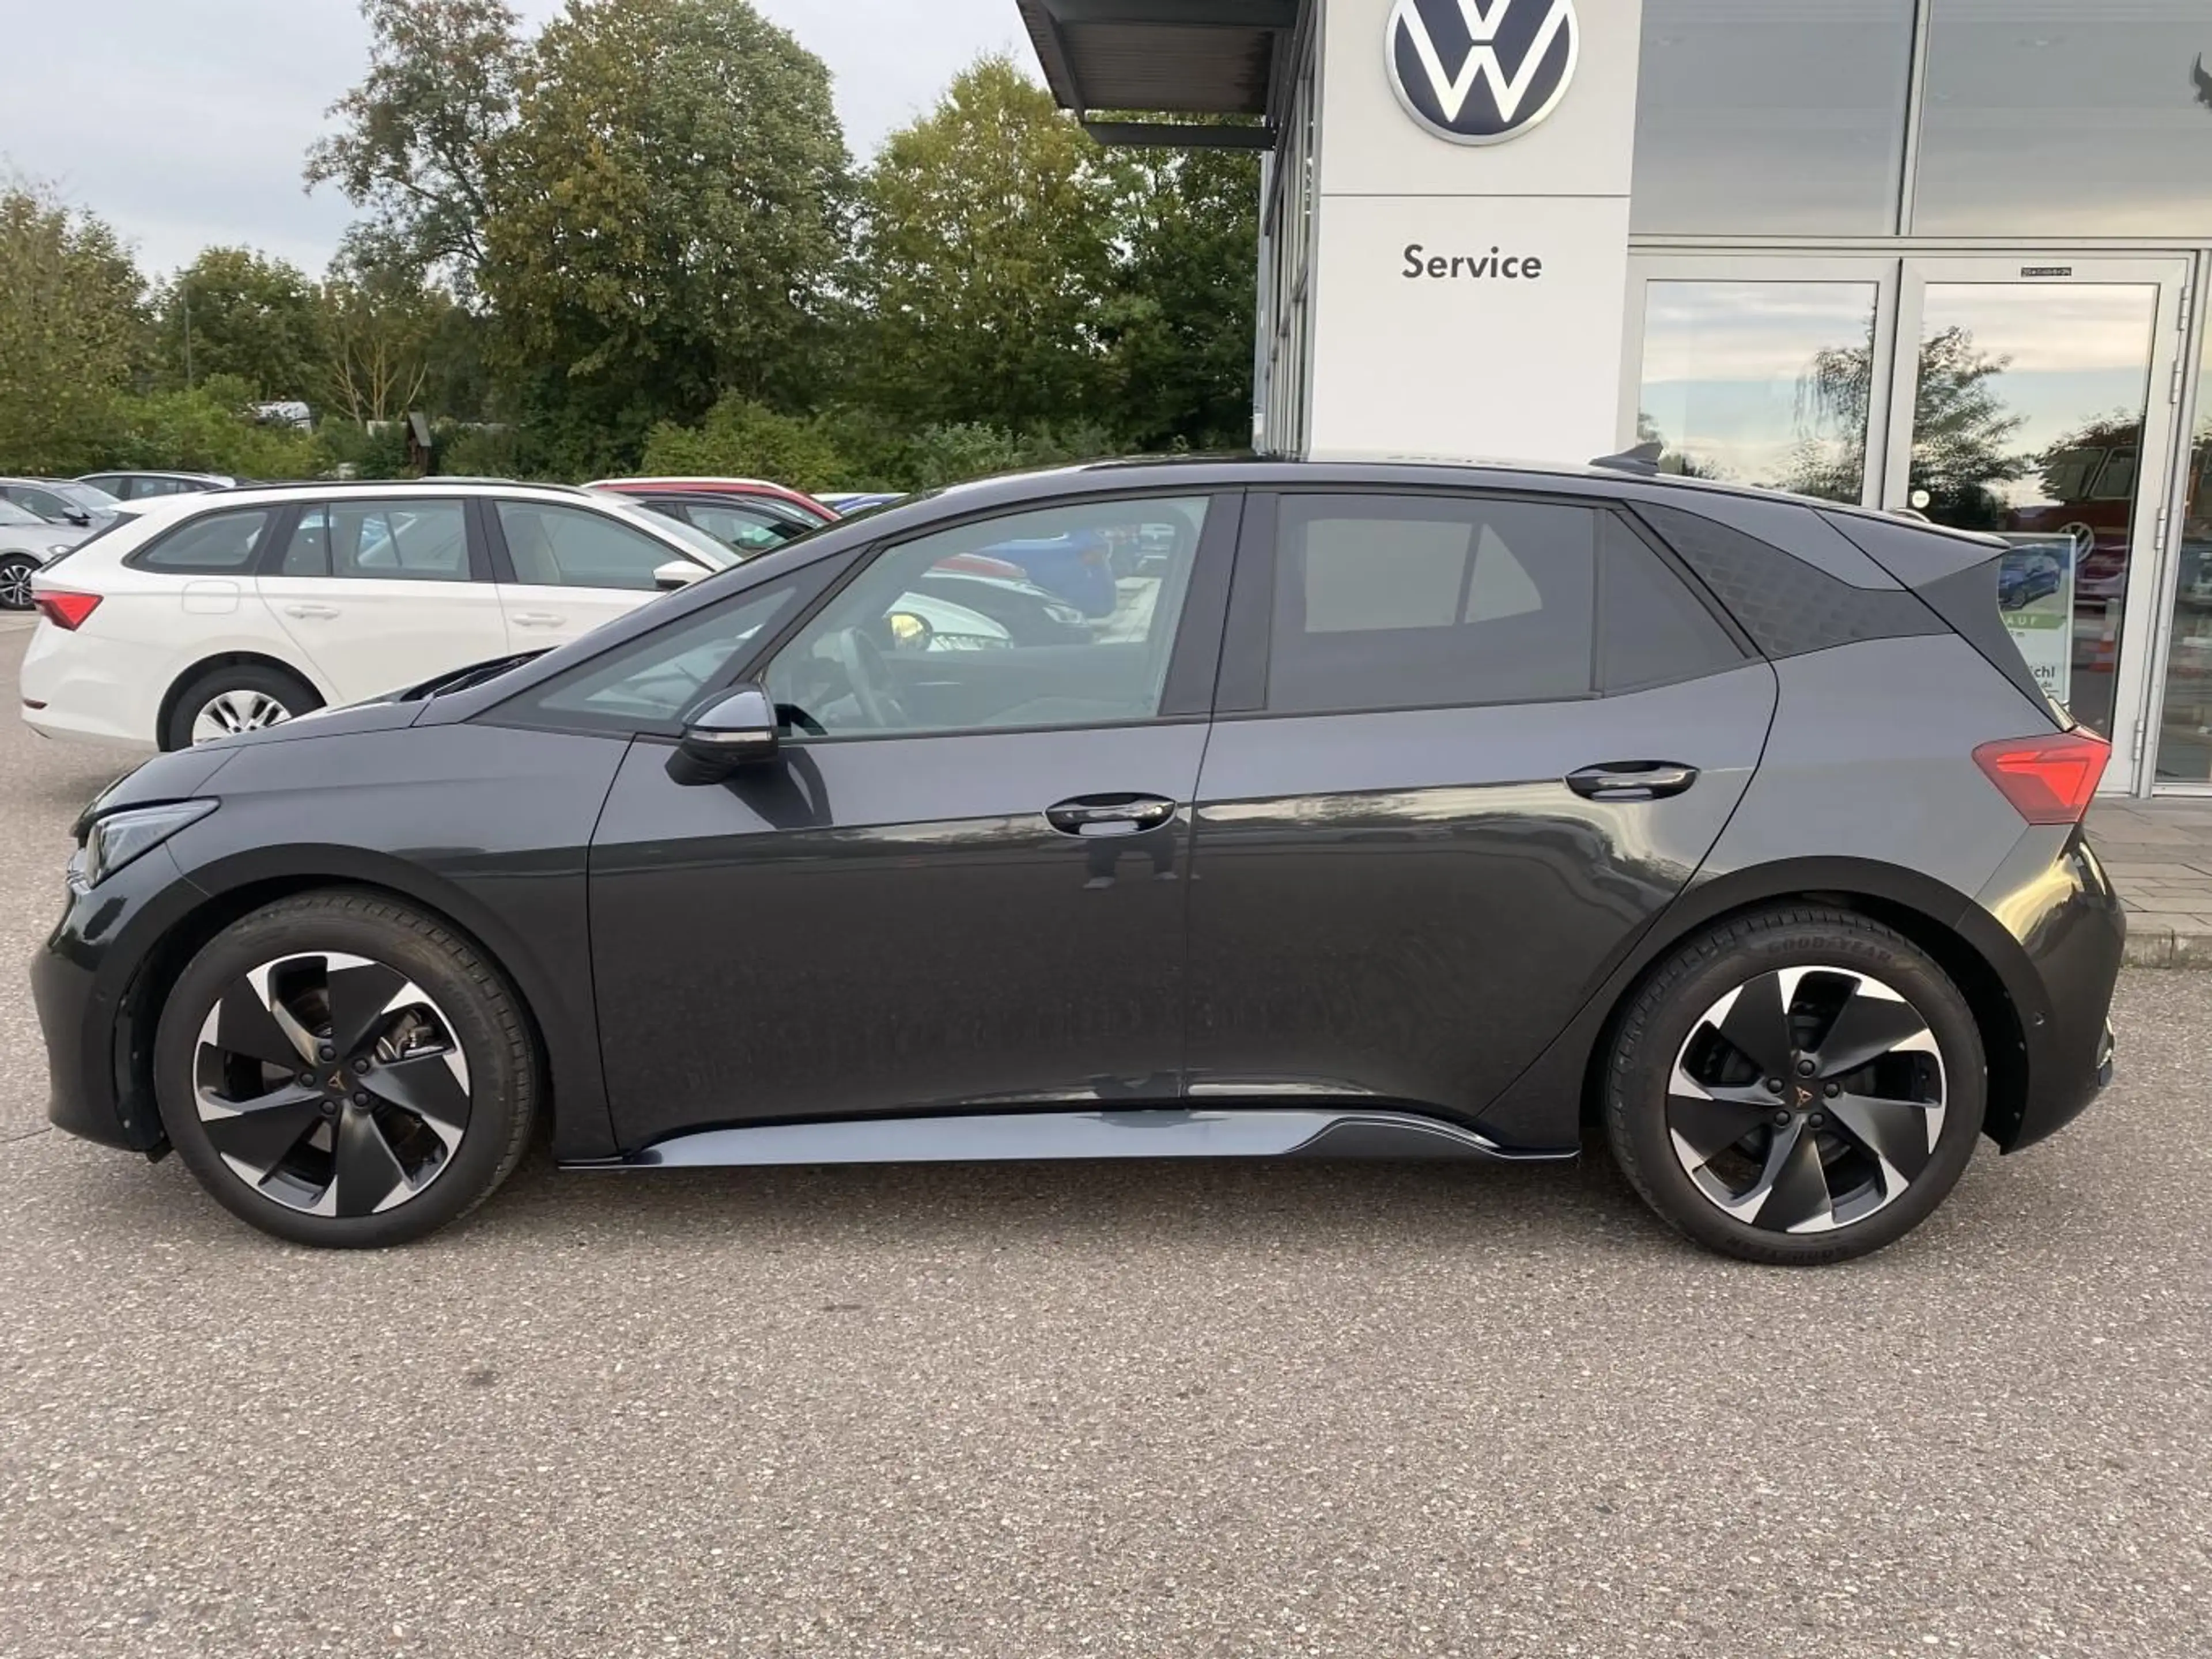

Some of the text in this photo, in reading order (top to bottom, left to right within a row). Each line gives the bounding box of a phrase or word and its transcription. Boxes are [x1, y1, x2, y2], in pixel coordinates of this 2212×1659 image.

[1402, 245, 1541, 278] Service
[2006, 615, 2038, 627] AUF
[2030, 665, 2056, 679] chl
